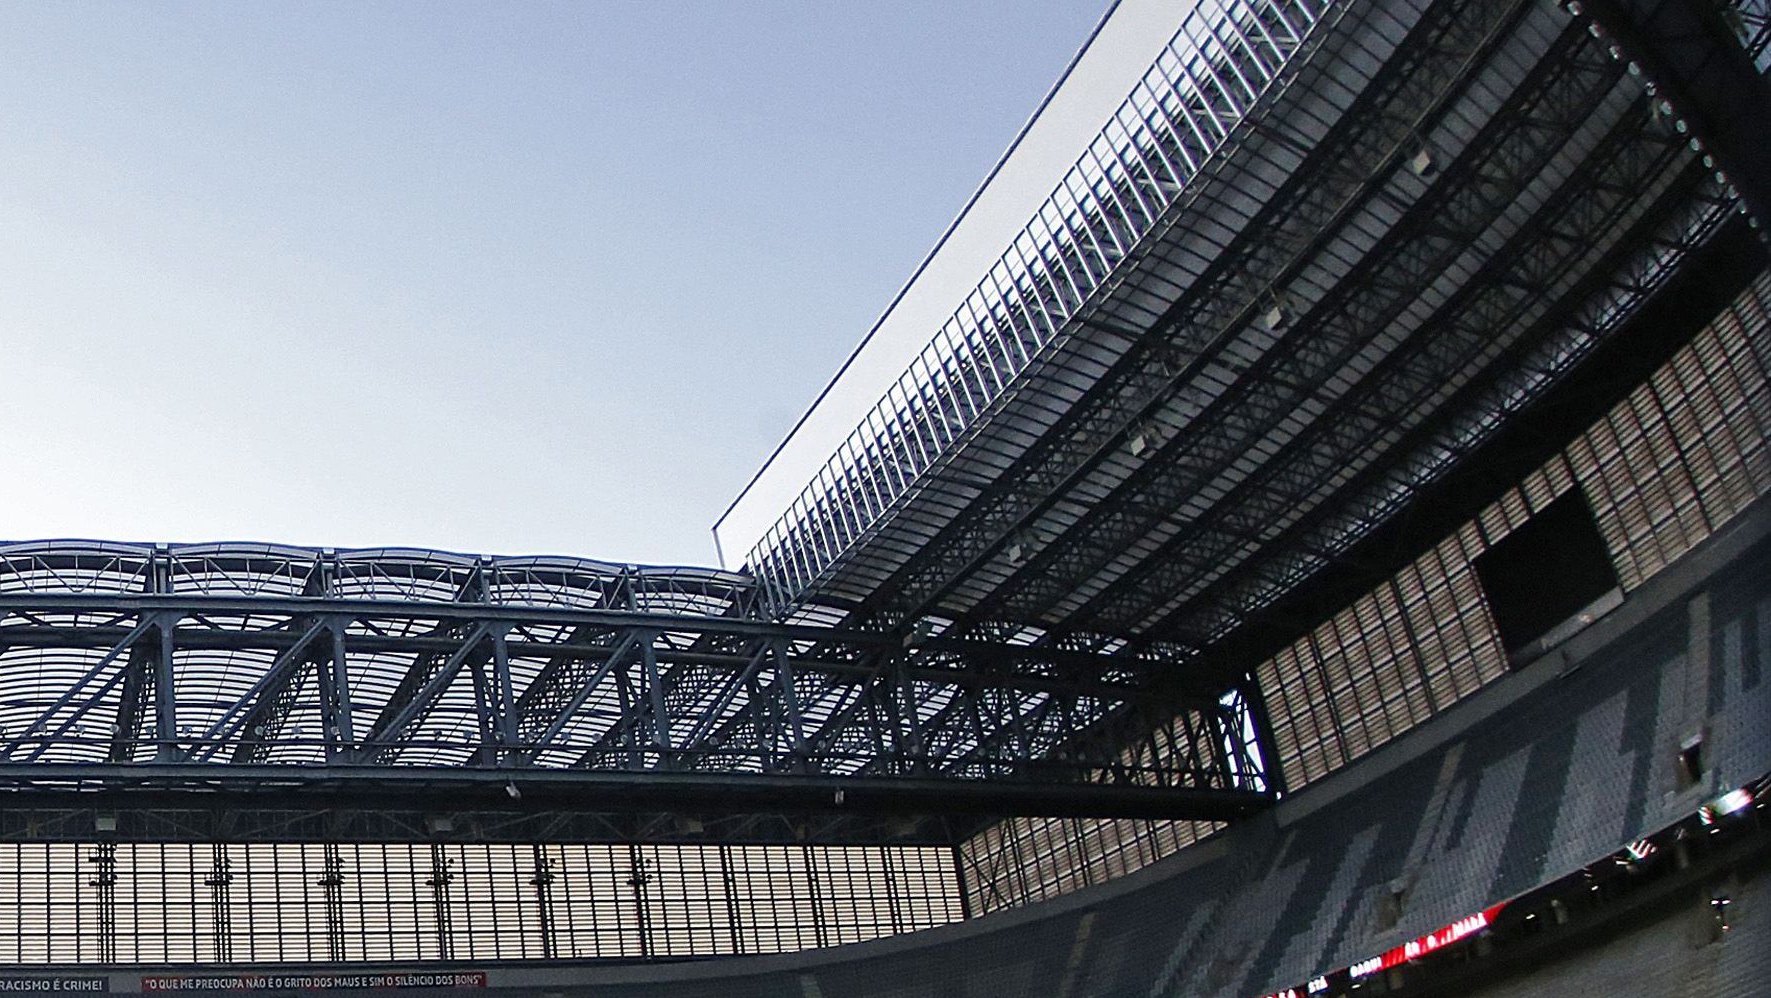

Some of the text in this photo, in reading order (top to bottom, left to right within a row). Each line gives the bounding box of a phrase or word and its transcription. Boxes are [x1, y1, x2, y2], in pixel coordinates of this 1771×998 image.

[53, 978, 61, 991] É
[63, 980, 103, 991] CRIME!
[158, 979, 179, 990] QUE
[180, 979, 194, 989] ME
[195, 978, 244, 989] PREOCUPA
[246, 976, 266, 989] NÃO
[275, 977, 282, 988] O
[284, 977, 312, 988] GRITO
[313, 977, 333, 988] DOS
[334, 976, 360, 988] MAUS
[361, 976, 367, 987] E
[369, 976, 385, 987] SIM
[386, 976, 393, 986] O
[435, 975, 453, 986] DOS
